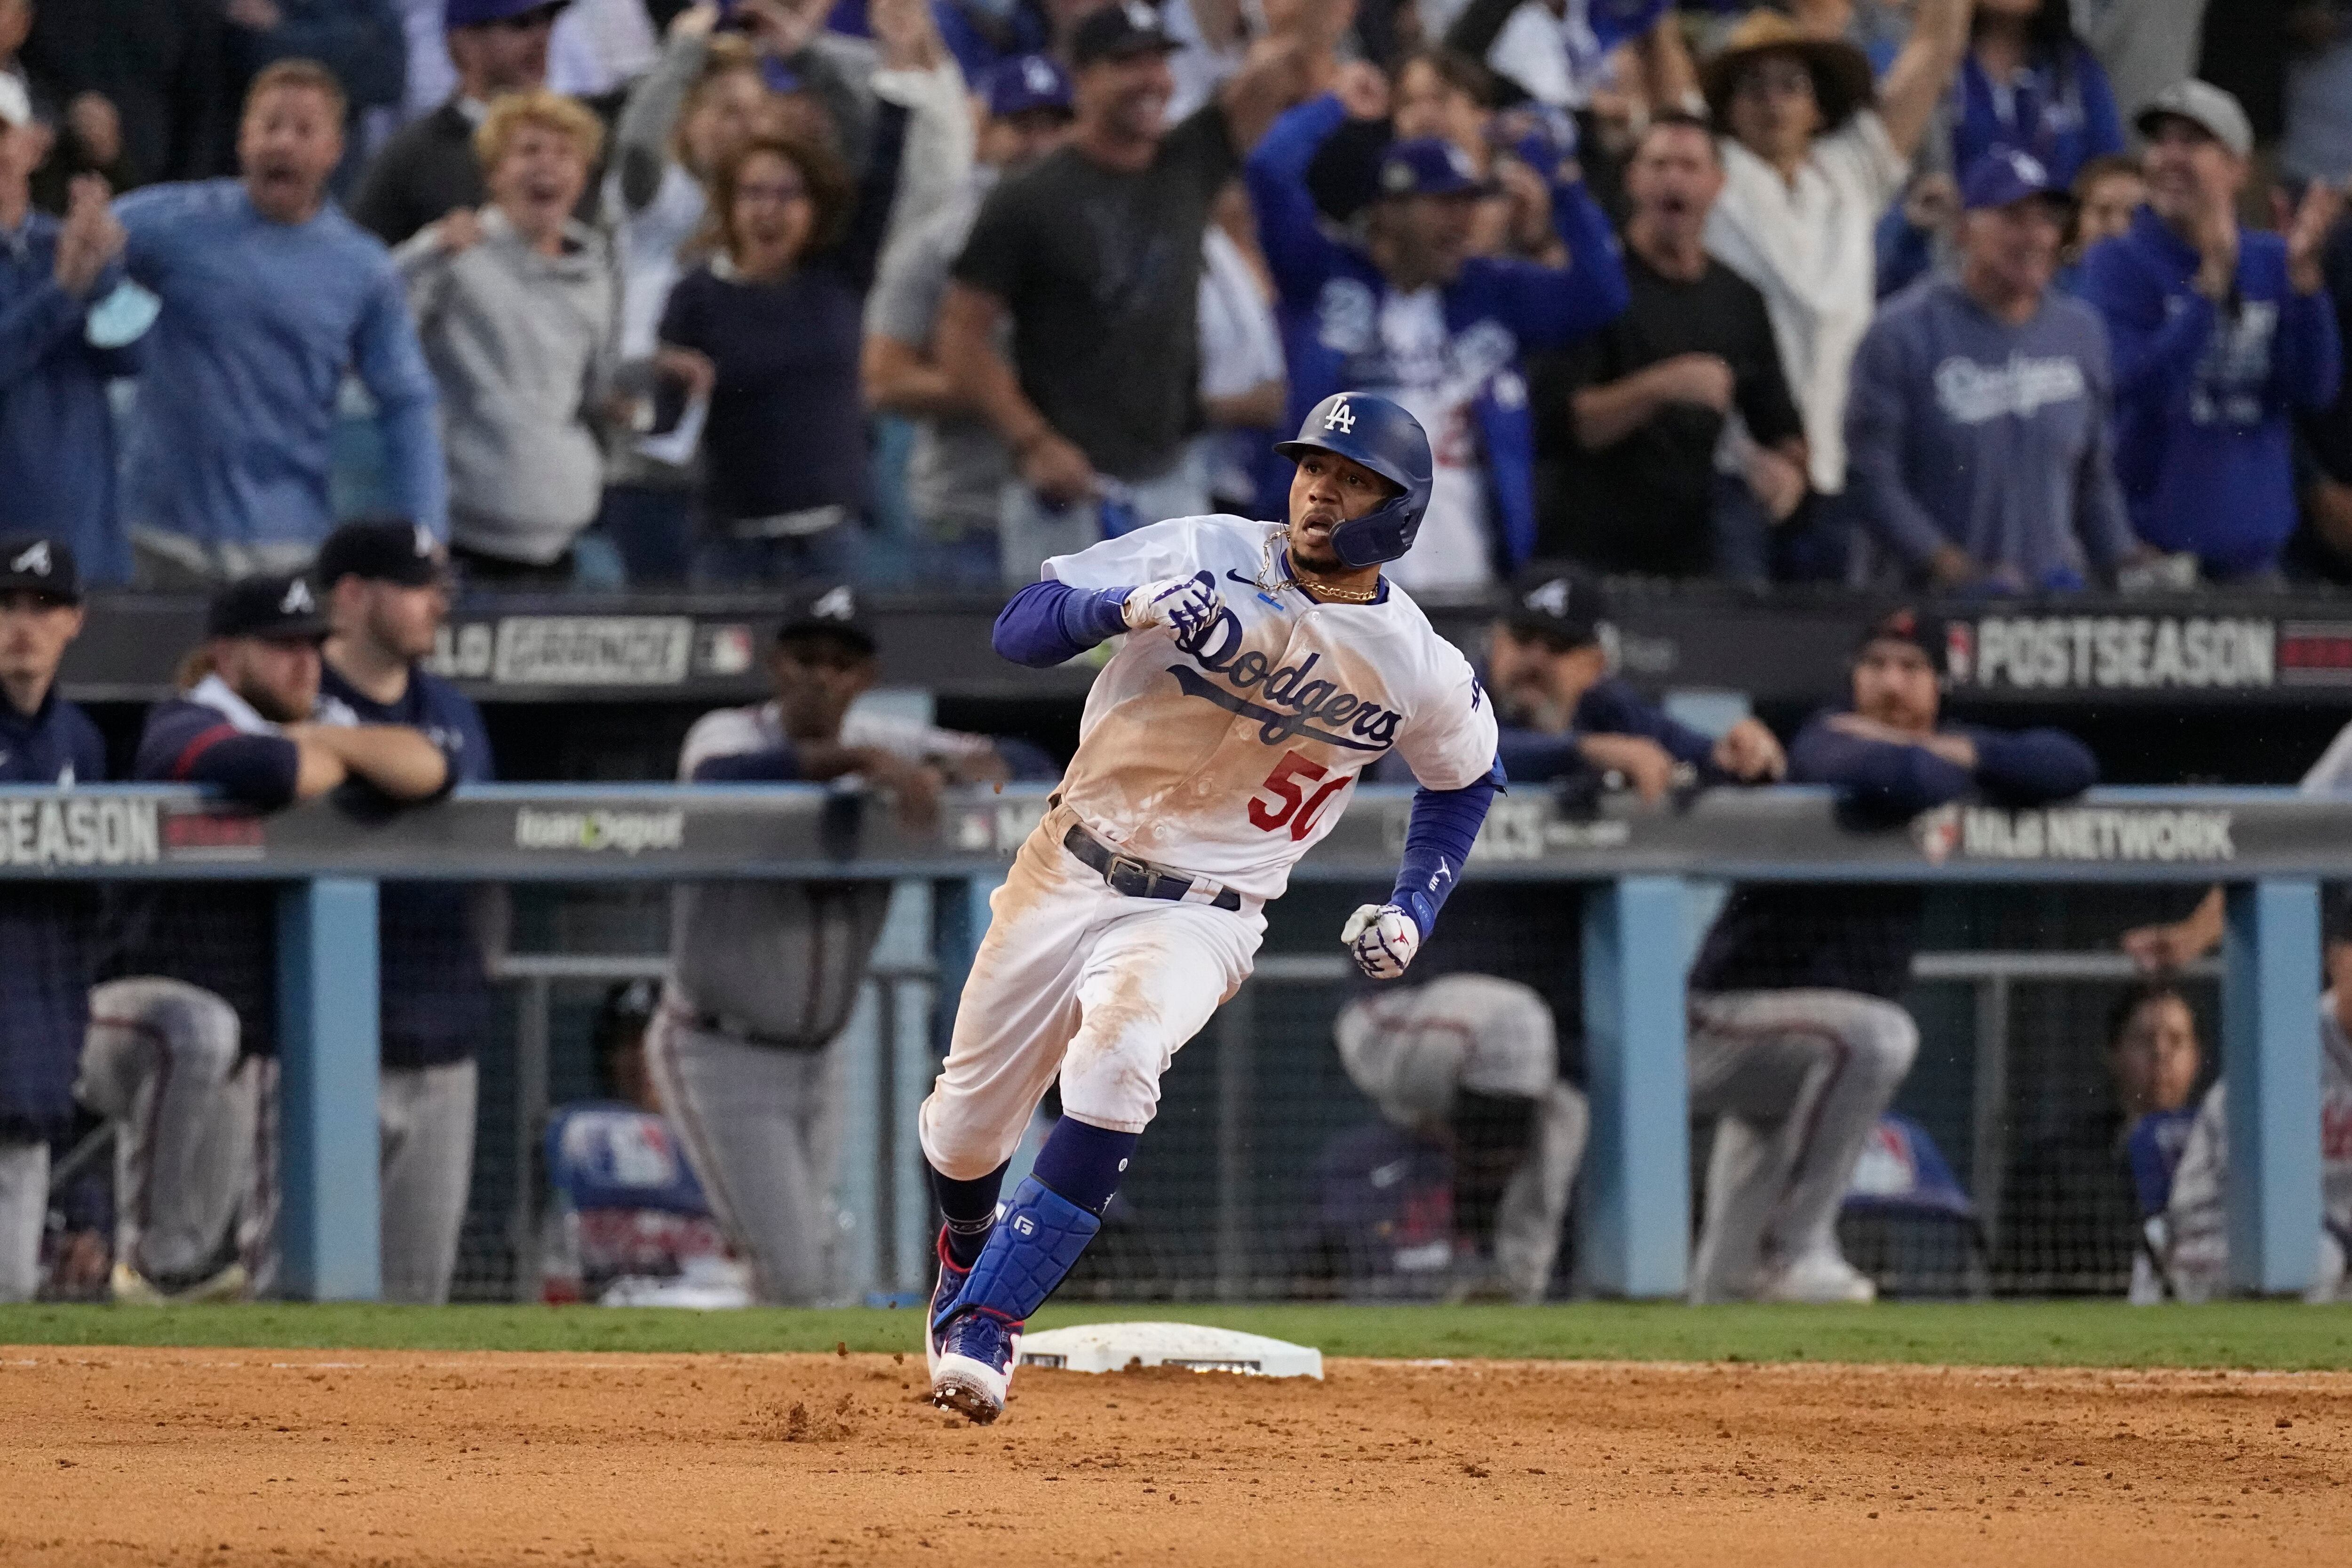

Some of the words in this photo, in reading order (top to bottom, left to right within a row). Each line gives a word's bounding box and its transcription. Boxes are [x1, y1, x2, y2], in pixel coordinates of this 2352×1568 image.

[1324, 396, 1356, 434] LA
[1166, 606, 1402, 752] Dodgers
[1977, 614, 2276, 689] POSTSEASON
[2045, 807, 2236, 861] NETWORK
